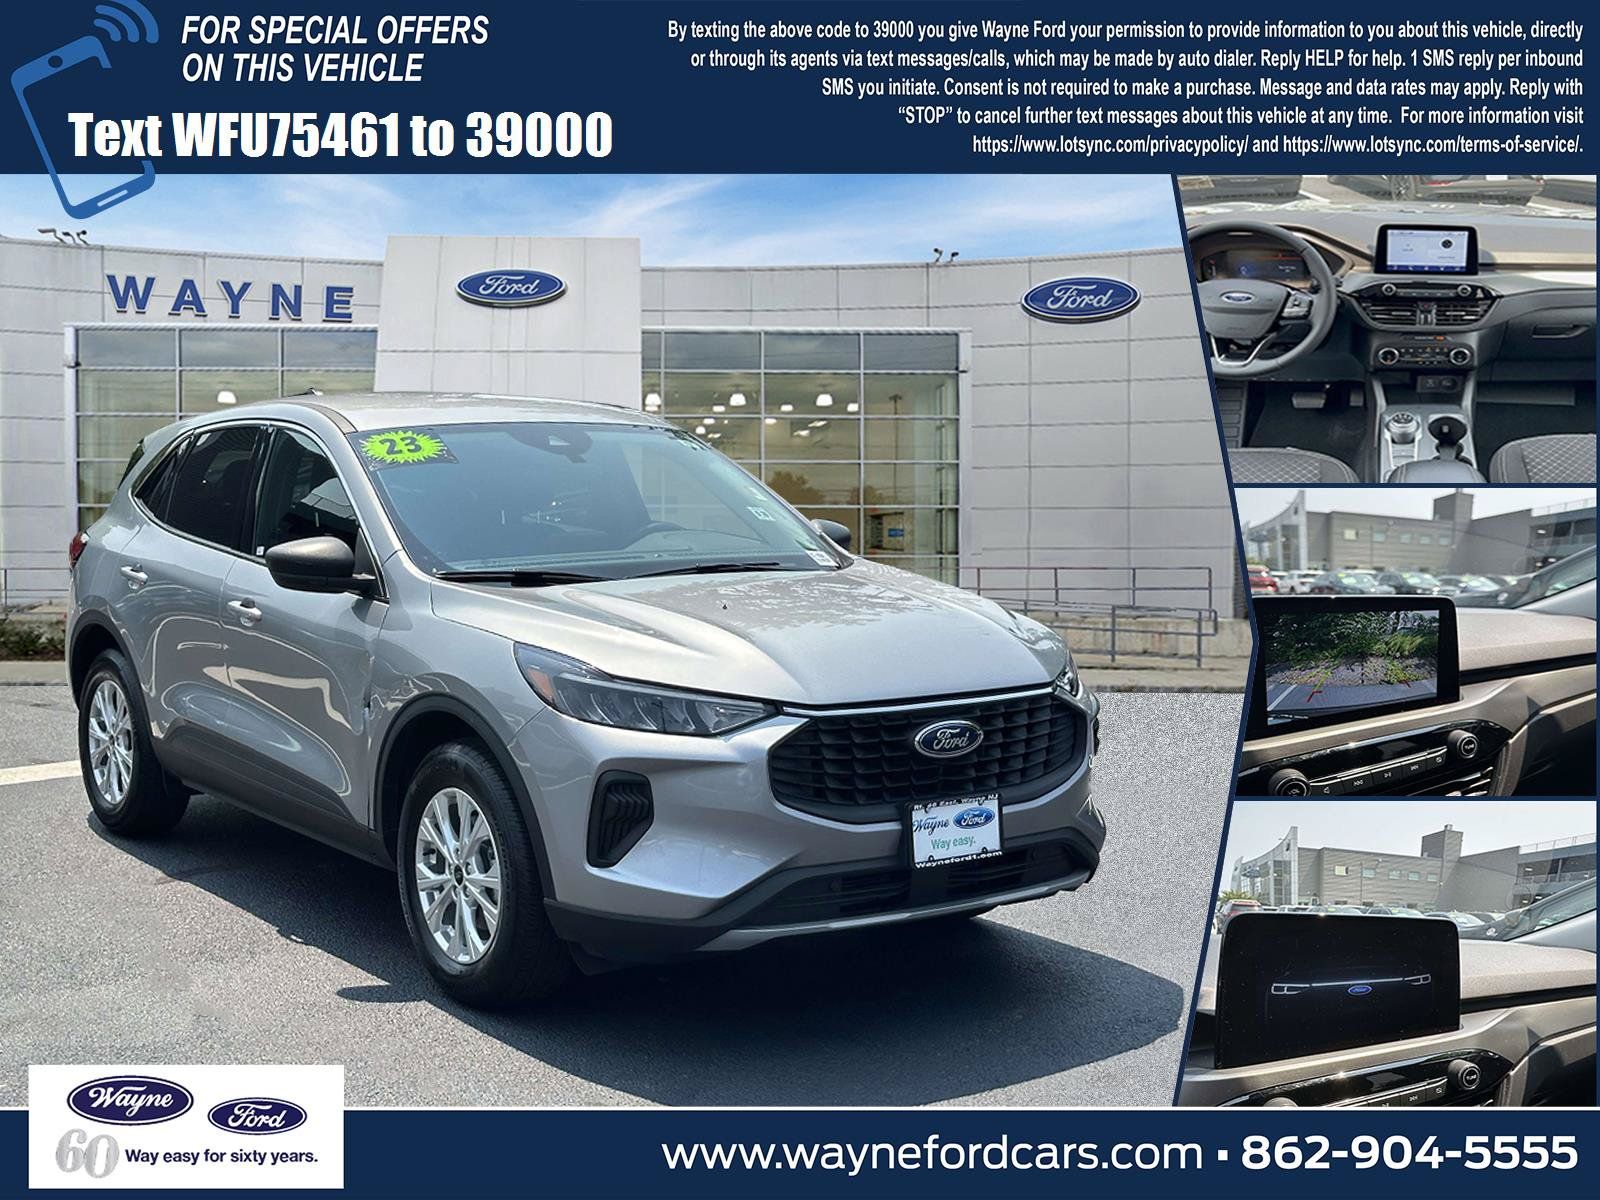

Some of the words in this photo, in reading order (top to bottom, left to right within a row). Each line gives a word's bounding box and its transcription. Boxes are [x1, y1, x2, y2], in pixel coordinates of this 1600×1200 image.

[477, 273, 541, 297] Ford
[106, 274, 354, 322] WAYNE
[1046, 285, 1114, 310] Ford
[379, 435, 423, 456] 23
[932, 727, 971, 750] Ford
[913, 815, 949, 836] Wayne
[961, 809, 985, 826] Ford
[930, 838, 952, 851] Way
[952, 835, 976, 848] easy.
[915, 850, 1003, 869] Wayneford1.com
